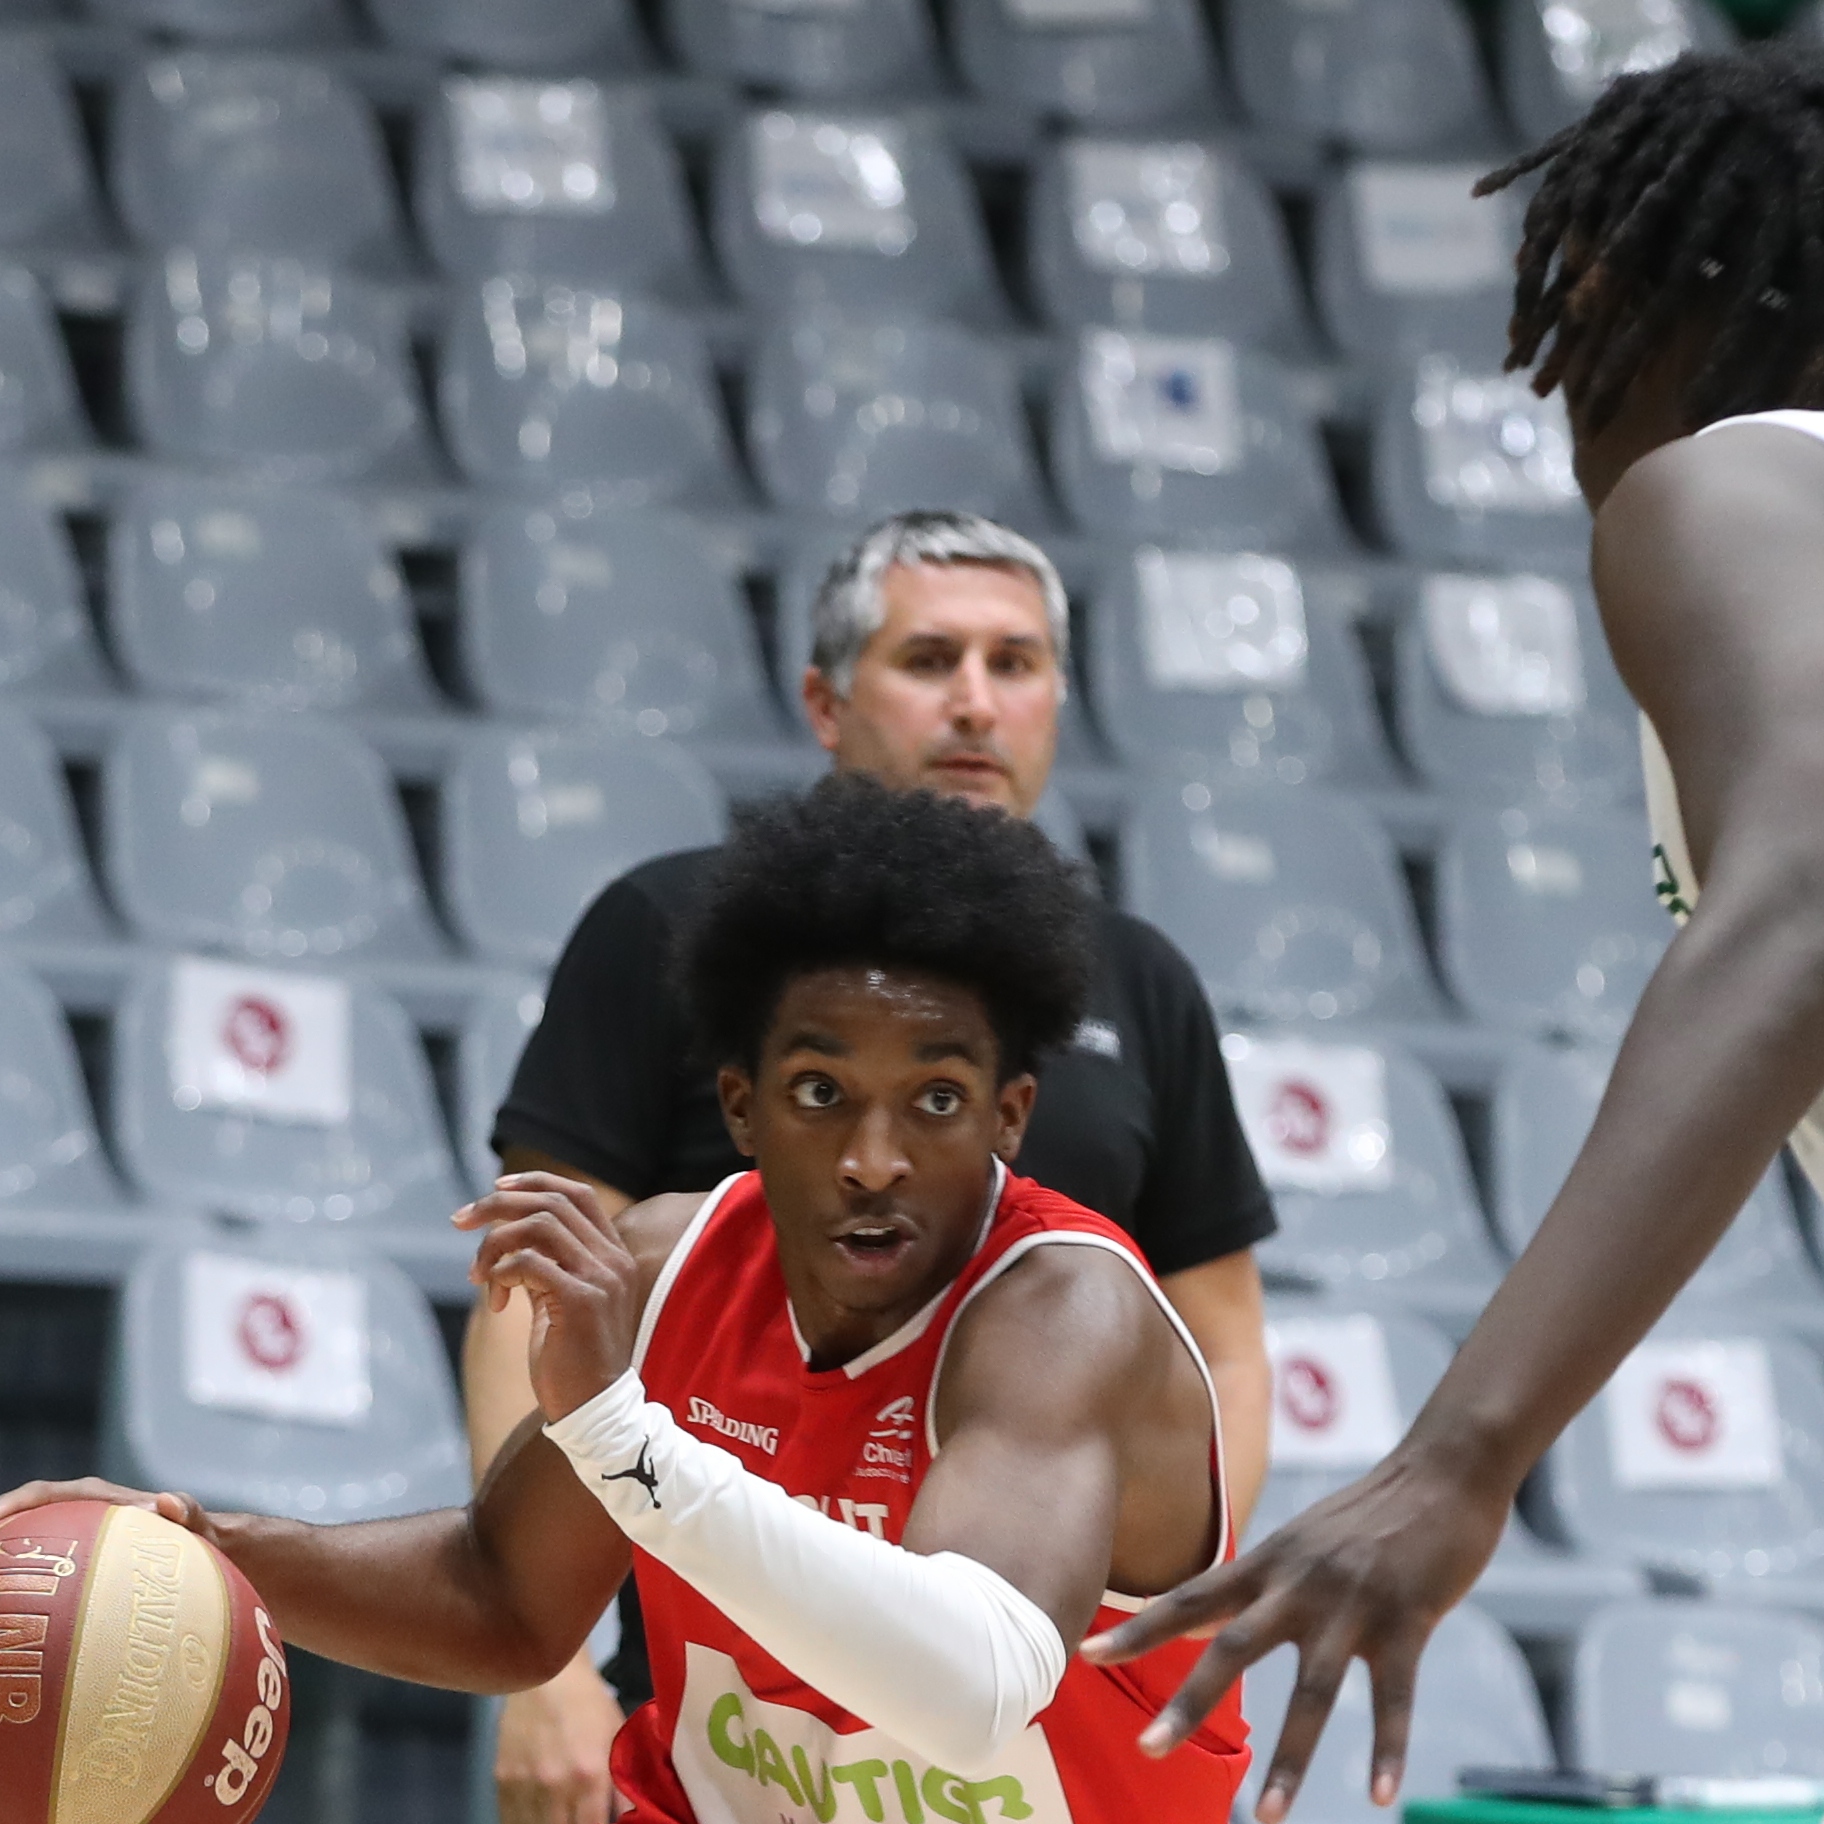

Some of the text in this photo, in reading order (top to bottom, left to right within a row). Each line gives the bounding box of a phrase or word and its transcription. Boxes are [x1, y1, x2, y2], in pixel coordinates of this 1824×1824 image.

[686, 1395, 780, 1456] SPALDING
[79, 1525, 186, 1783] SPALDING
[214, 1606, 288, 1806] Jeep
